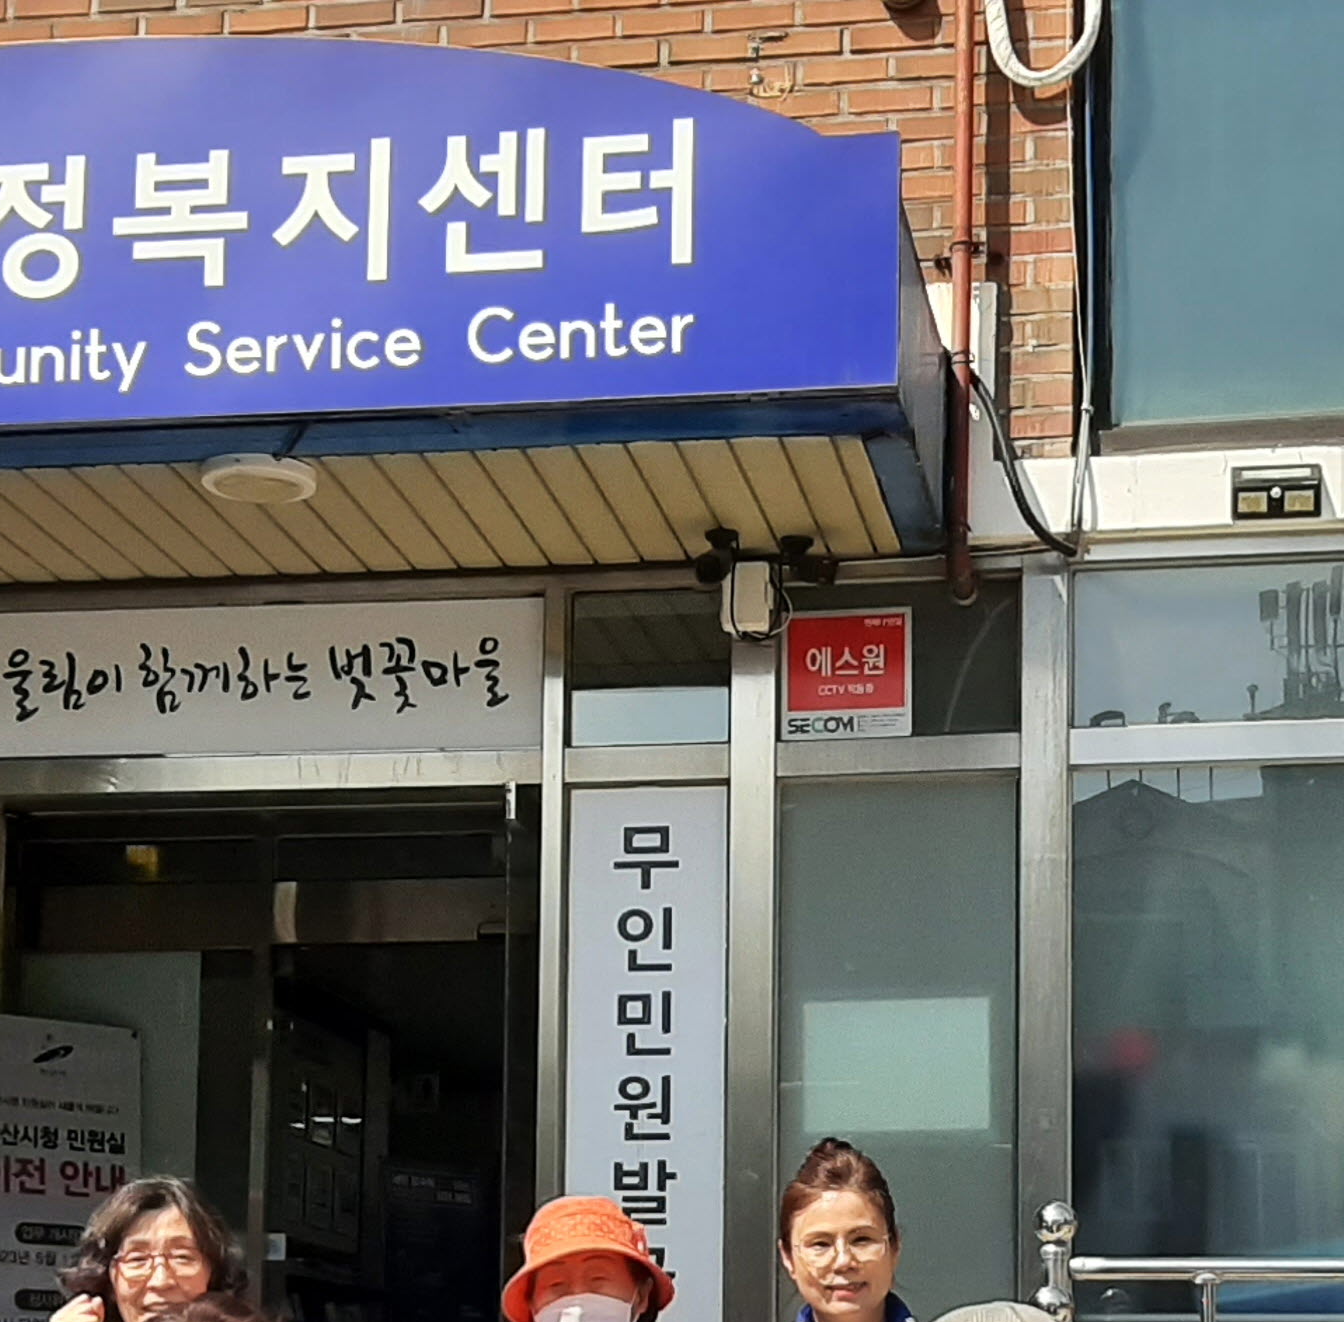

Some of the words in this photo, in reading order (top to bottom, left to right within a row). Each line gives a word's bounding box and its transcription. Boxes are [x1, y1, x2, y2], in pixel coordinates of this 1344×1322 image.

[185, 317, 422, 377] Service
[467, 302, 695, 365] Center
[138, 642, 313, 714] 함께하는
[329, 636, 510, 714] 벚꽃마을
[805, 643, 885, 677] 에스원
[787, 715, 855, 735] SECOM
[66, 1128, 126, 1155] 민원실
[59, 1160, 127, 1198] 안내
